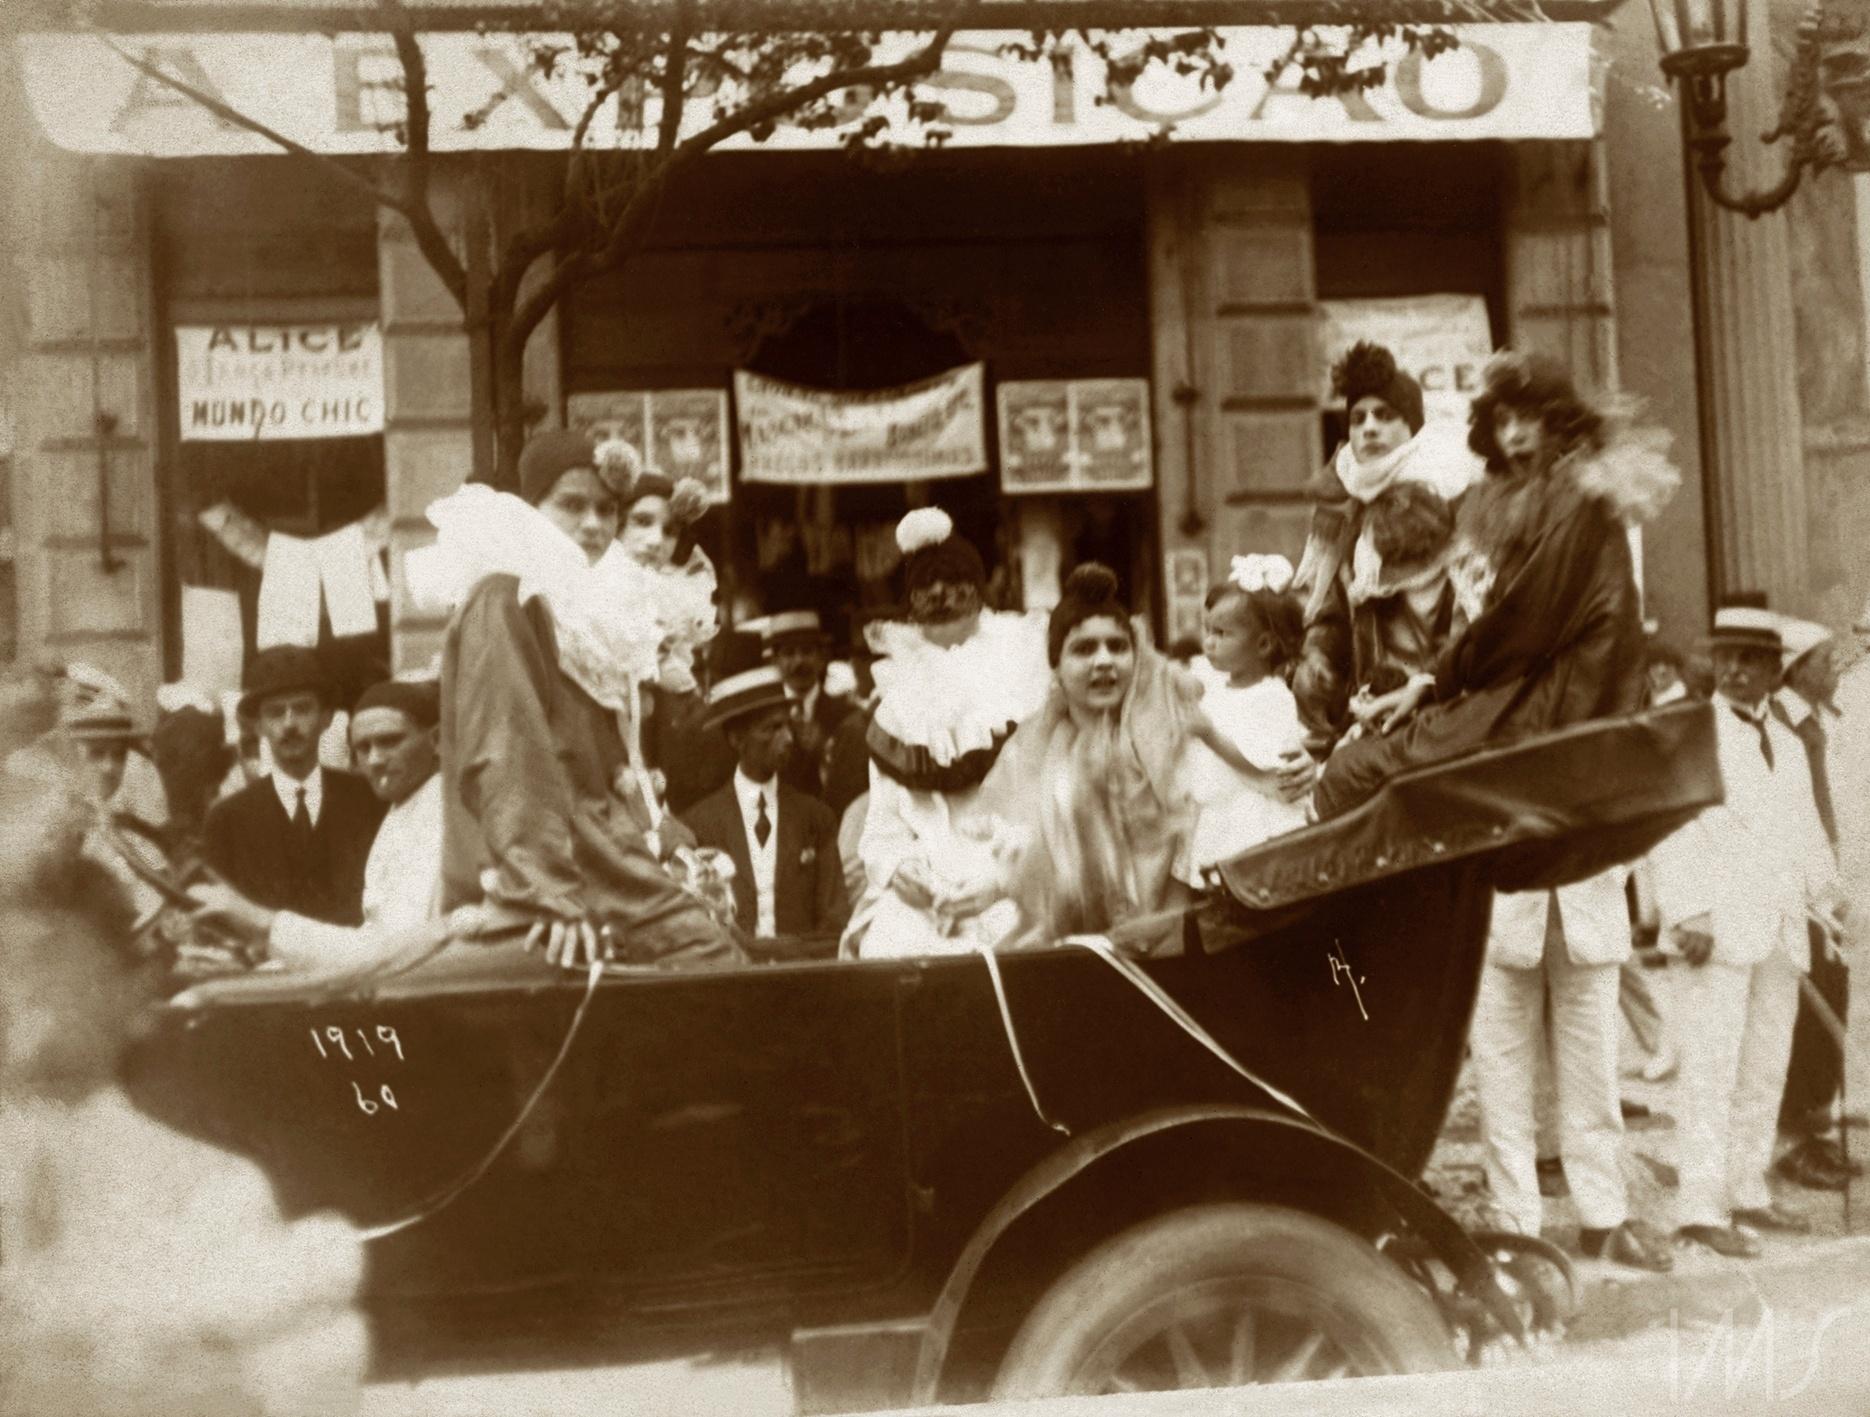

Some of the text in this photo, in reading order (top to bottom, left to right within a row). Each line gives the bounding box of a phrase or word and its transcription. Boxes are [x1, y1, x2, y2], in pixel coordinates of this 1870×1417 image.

[108, 48, 246, 131] A
[192, 400, 371, 426] MUNDO CHIC
[310, 1024, 404, 1061] 1919
